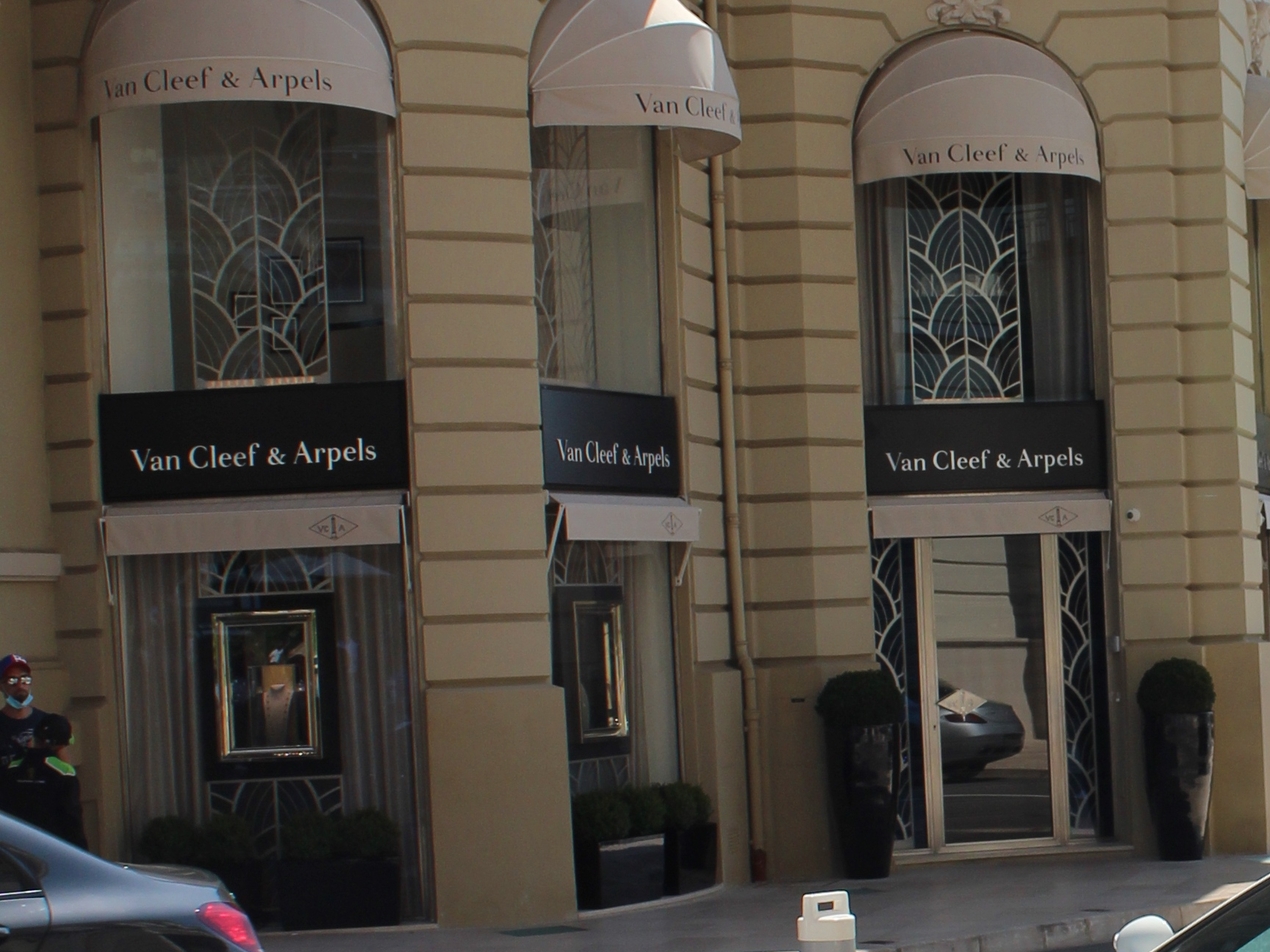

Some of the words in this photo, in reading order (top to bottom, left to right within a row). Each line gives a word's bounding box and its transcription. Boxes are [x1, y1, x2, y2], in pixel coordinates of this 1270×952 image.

[104, 79, 137, 99] Van
[143, 66, 213, 93] Cleef
[221, 70, 240, 88] &
[249, 66, 333, 96] Arpels
[635, 93, 679, 114] Van
[685, 95, 727, 121] Cleef
[903, 147, 940, 166] Van
[947, 143, 1008, 163] Cleef
[1014, 147, 1029, 163] &
[1034, 144, 1085, 170] Arpels
[131, 448, 181, 472] Van
[188, 442, 260, 469] Cleef
[266, 447, 286, 465] &
[293, 438, 377, 470] Arpels
[557, 438, 583, 463] Van
[585, 440, 619, 465] Cleef
[621, 448, 632, 466] &
[633, 444, 671, 474] Arpels
[886, 452, 926, 472] Van
[932, 449, 991, 470] Cleef
[996, 452, 1012, 469] &
[1017, 447, 1084, 474] Arpels
